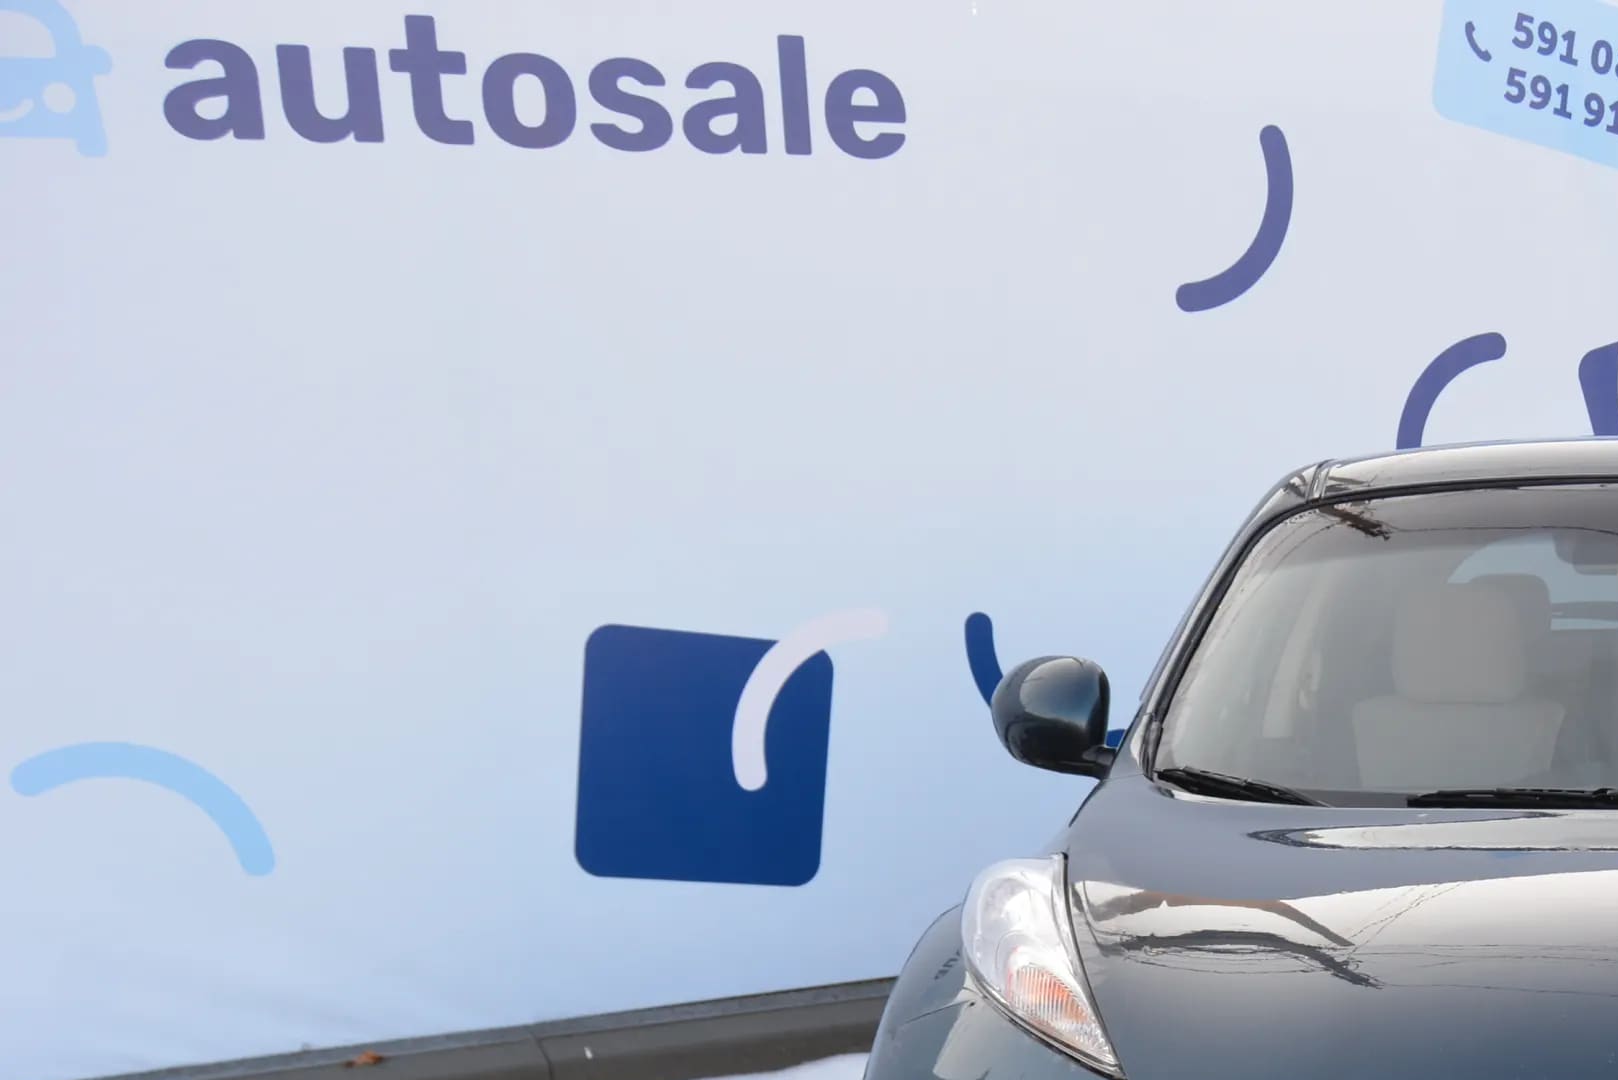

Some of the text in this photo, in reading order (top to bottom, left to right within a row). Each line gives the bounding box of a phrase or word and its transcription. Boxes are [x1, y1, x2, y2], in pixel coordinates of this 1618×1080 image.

[1511, 12, 1579, 67] 591
[162, 13, 908, 160] autosale
[1503, 66, 1573, 120] 591
